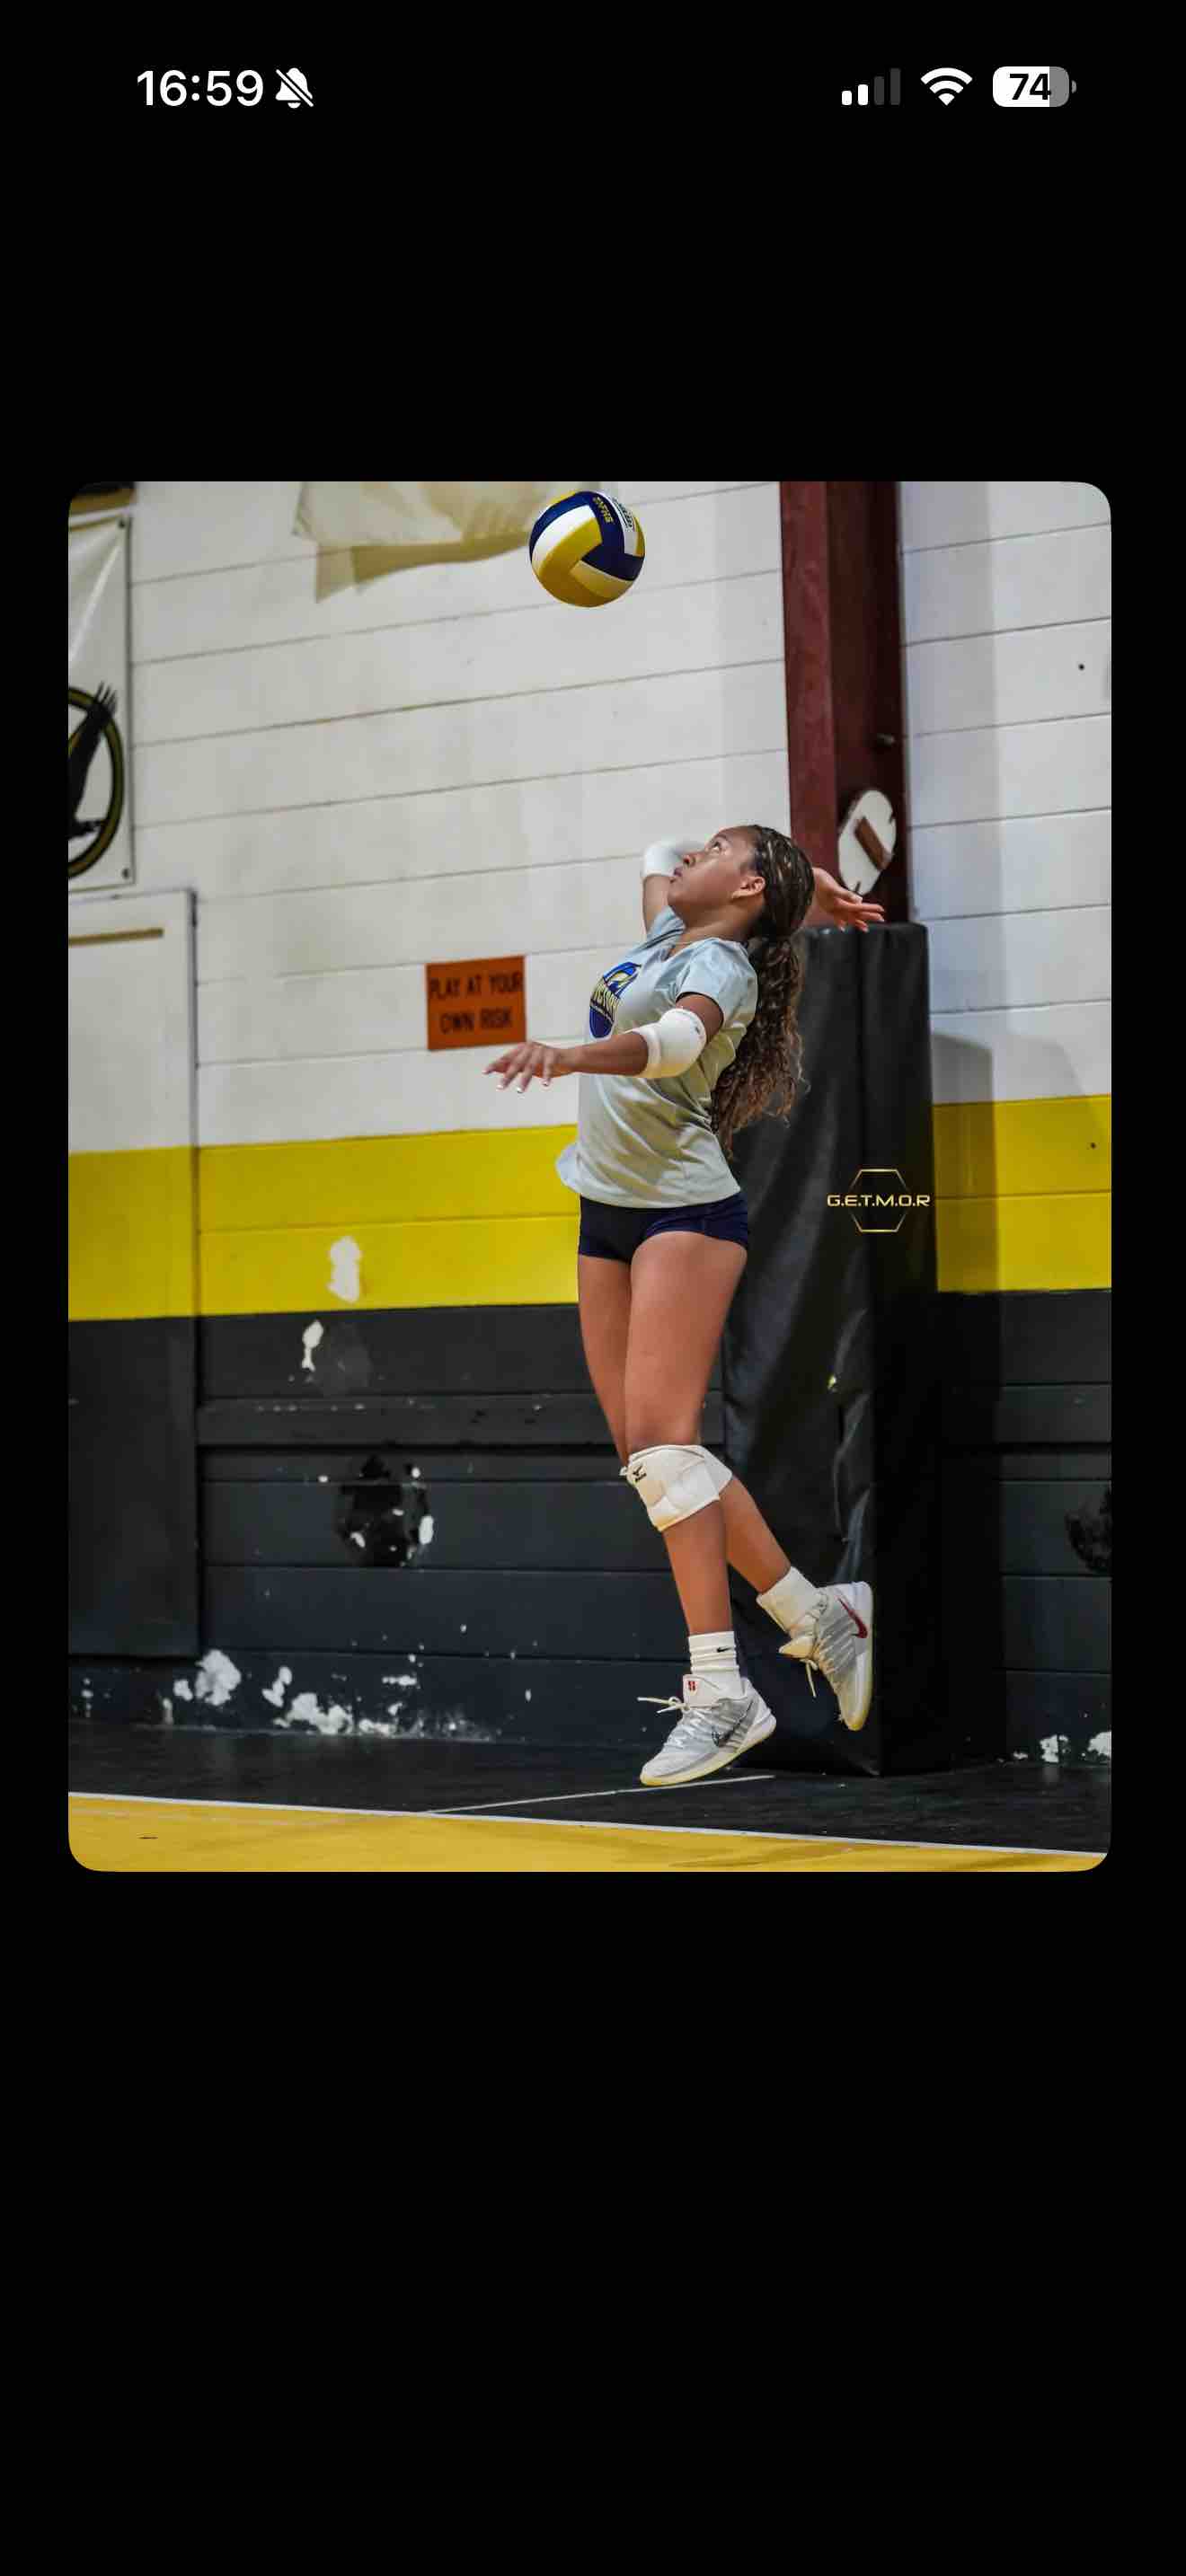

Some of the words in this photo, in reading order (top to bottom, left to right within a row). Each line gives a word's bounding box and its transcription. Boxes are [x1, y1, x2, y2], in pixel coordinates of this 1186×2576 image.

[429, 976, 461, 1000] PLAY
[465, 974, 482, 997] AT
[488, 970, 524, 995] YOUR
[439, 1010, 475, 1035] OWN
[481, 1007, 512, 1029] RISK
